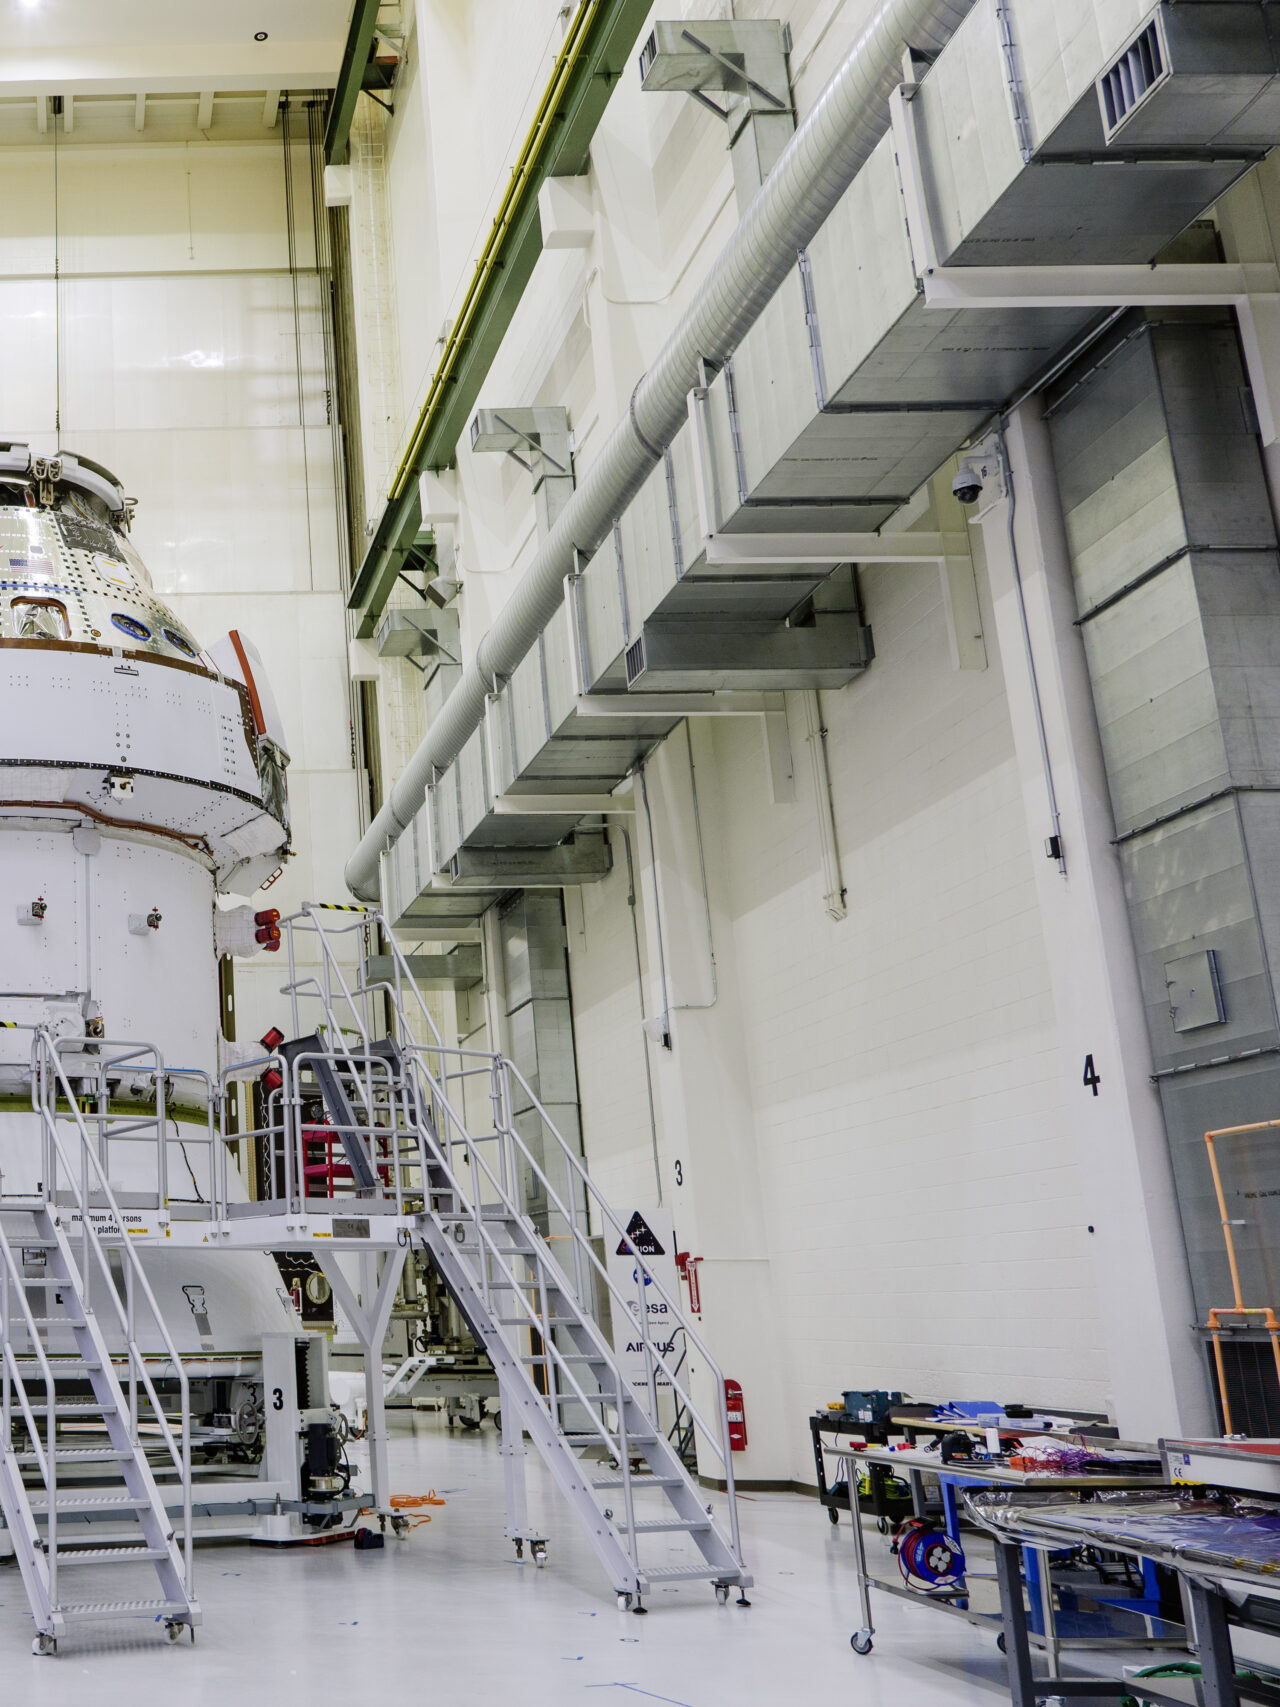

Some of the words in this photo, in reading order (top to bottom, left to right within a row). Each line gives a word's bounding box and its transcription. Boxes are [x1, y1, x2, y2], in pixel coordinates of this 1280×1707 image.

[1083, 1053, 1101, 1097] 4
[675, 1159, 683, 1187] 3
[71, 1214, 107, 1222] mamum
[97, 1225, 121, 1235] platfor
[626, 1341, 675, 1353] AIUS
[272, 1388, 284, 1411] 3
